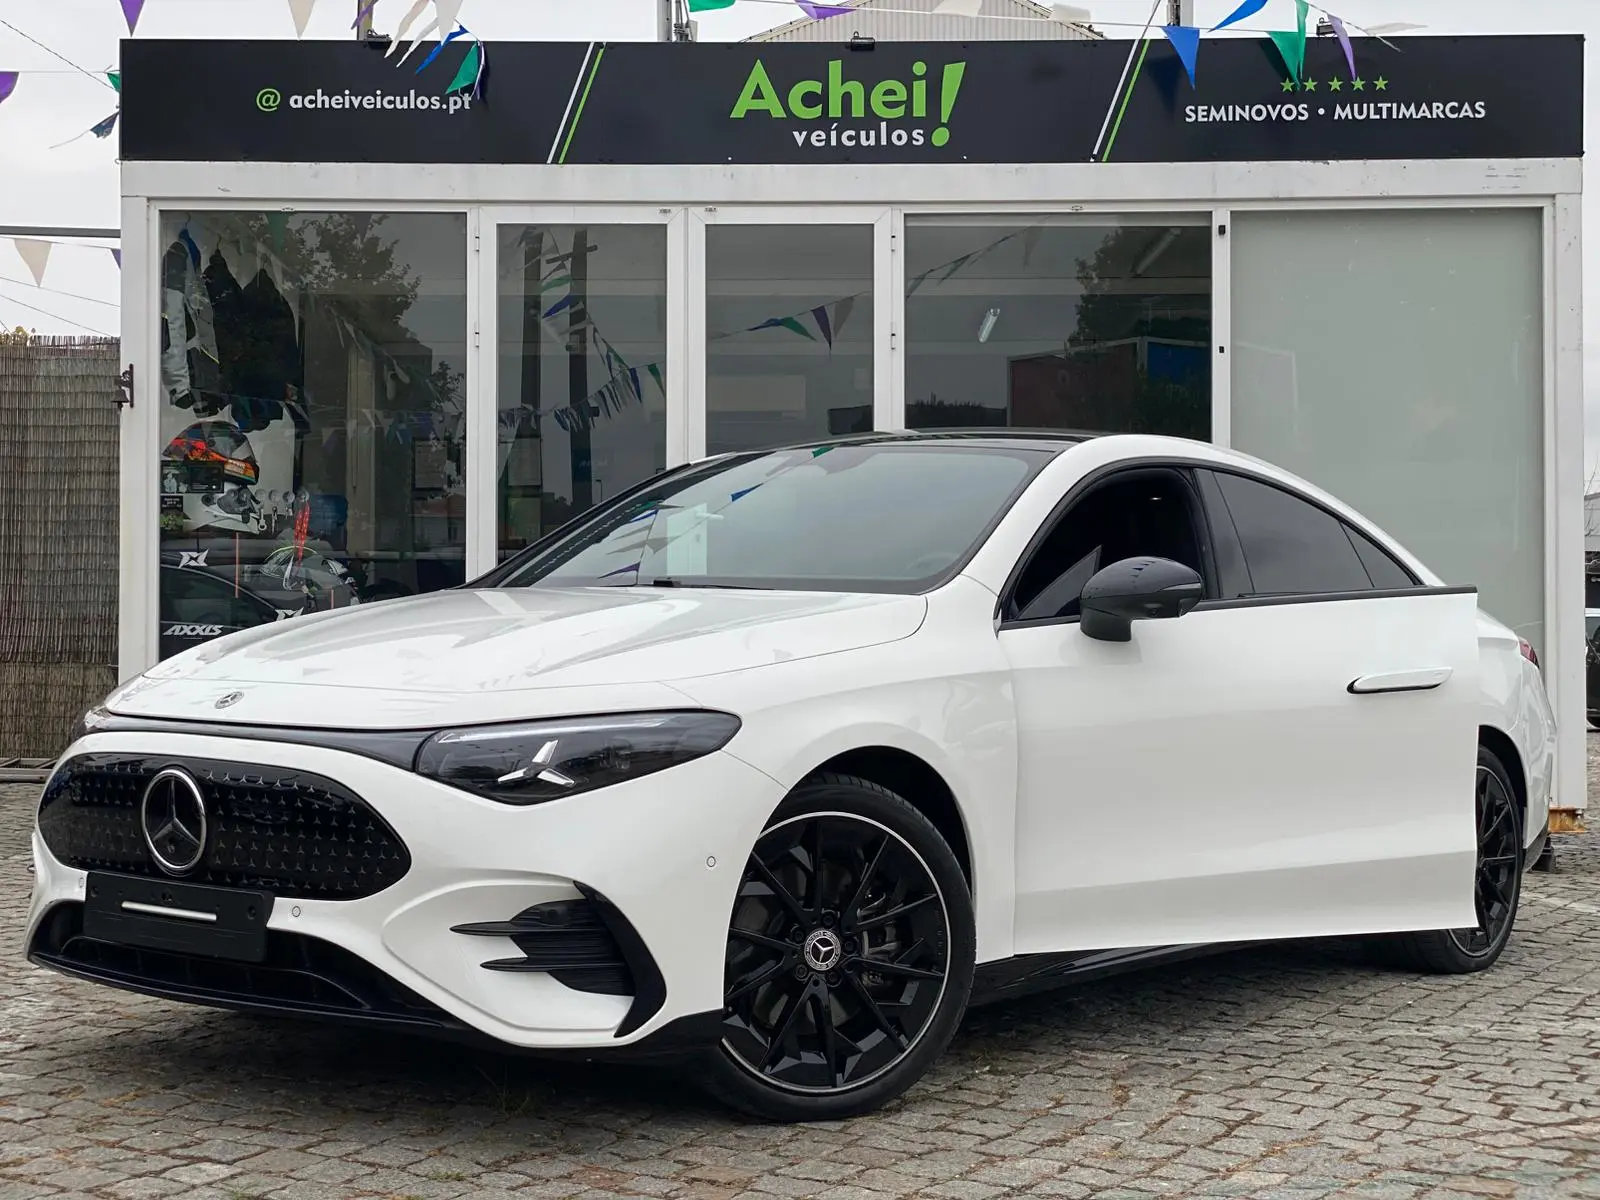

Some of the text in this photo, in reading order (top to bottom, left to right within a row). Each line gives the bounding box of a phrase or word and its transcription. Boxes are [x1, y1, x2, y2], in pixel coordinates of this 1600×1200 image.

[256, 88, 472, 114] @ acheiveiculos.pt
[730, 59, 966, 147] Achei!
[1184, 101, 1487, 122] SEMINOVOS MULTIMARCAS
[792, 121, 925, 147] veículos
[162, 624, 224, 636] AXXIS
